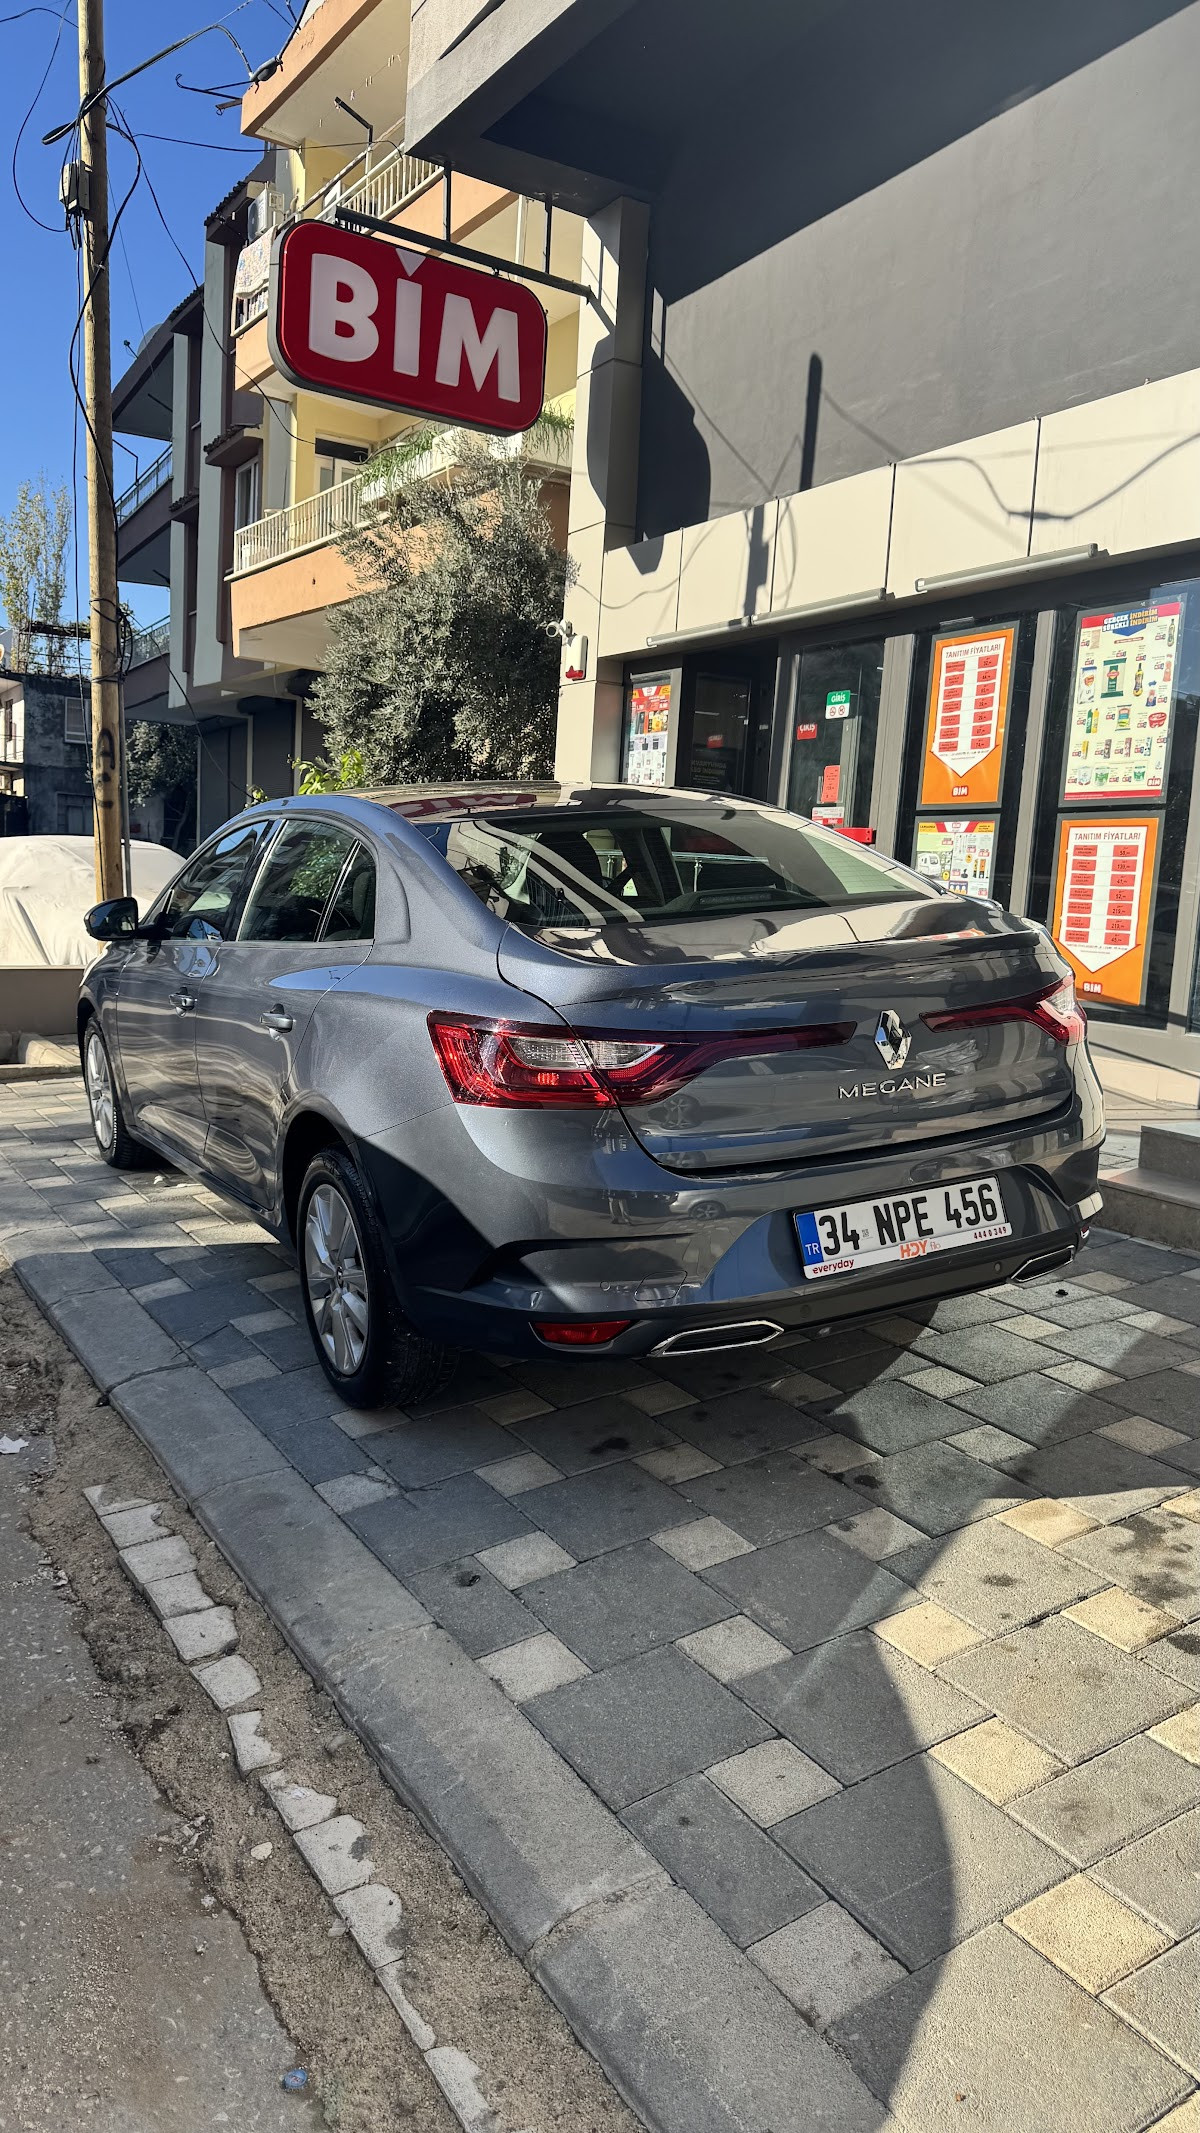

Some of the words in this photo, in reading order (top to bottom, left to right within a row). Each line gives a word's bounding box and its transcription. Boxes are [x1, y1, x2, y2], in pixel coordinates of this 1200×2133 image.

[945, 648, 970, 659] TANITIM
[969, 643, 1001, 655] FİYATLARI
[830, 692, 845, 702] GİRİŞ
[1074, 832, 1102, 840] TANITIM
[1103, 830, 1141, 840] FİYATLARI
[838, 1072, 947, 1099] MEGANE
[818, 1211, 860, 1256] 34
[873, 1196, 934, 1246] NPE
[944, 1183, 998, 1228] 456
[805, 1243, 820, 1256] TR
[900, 1239, 928, 1259] HDY
[812, 1258, 855, 1275] everyday
